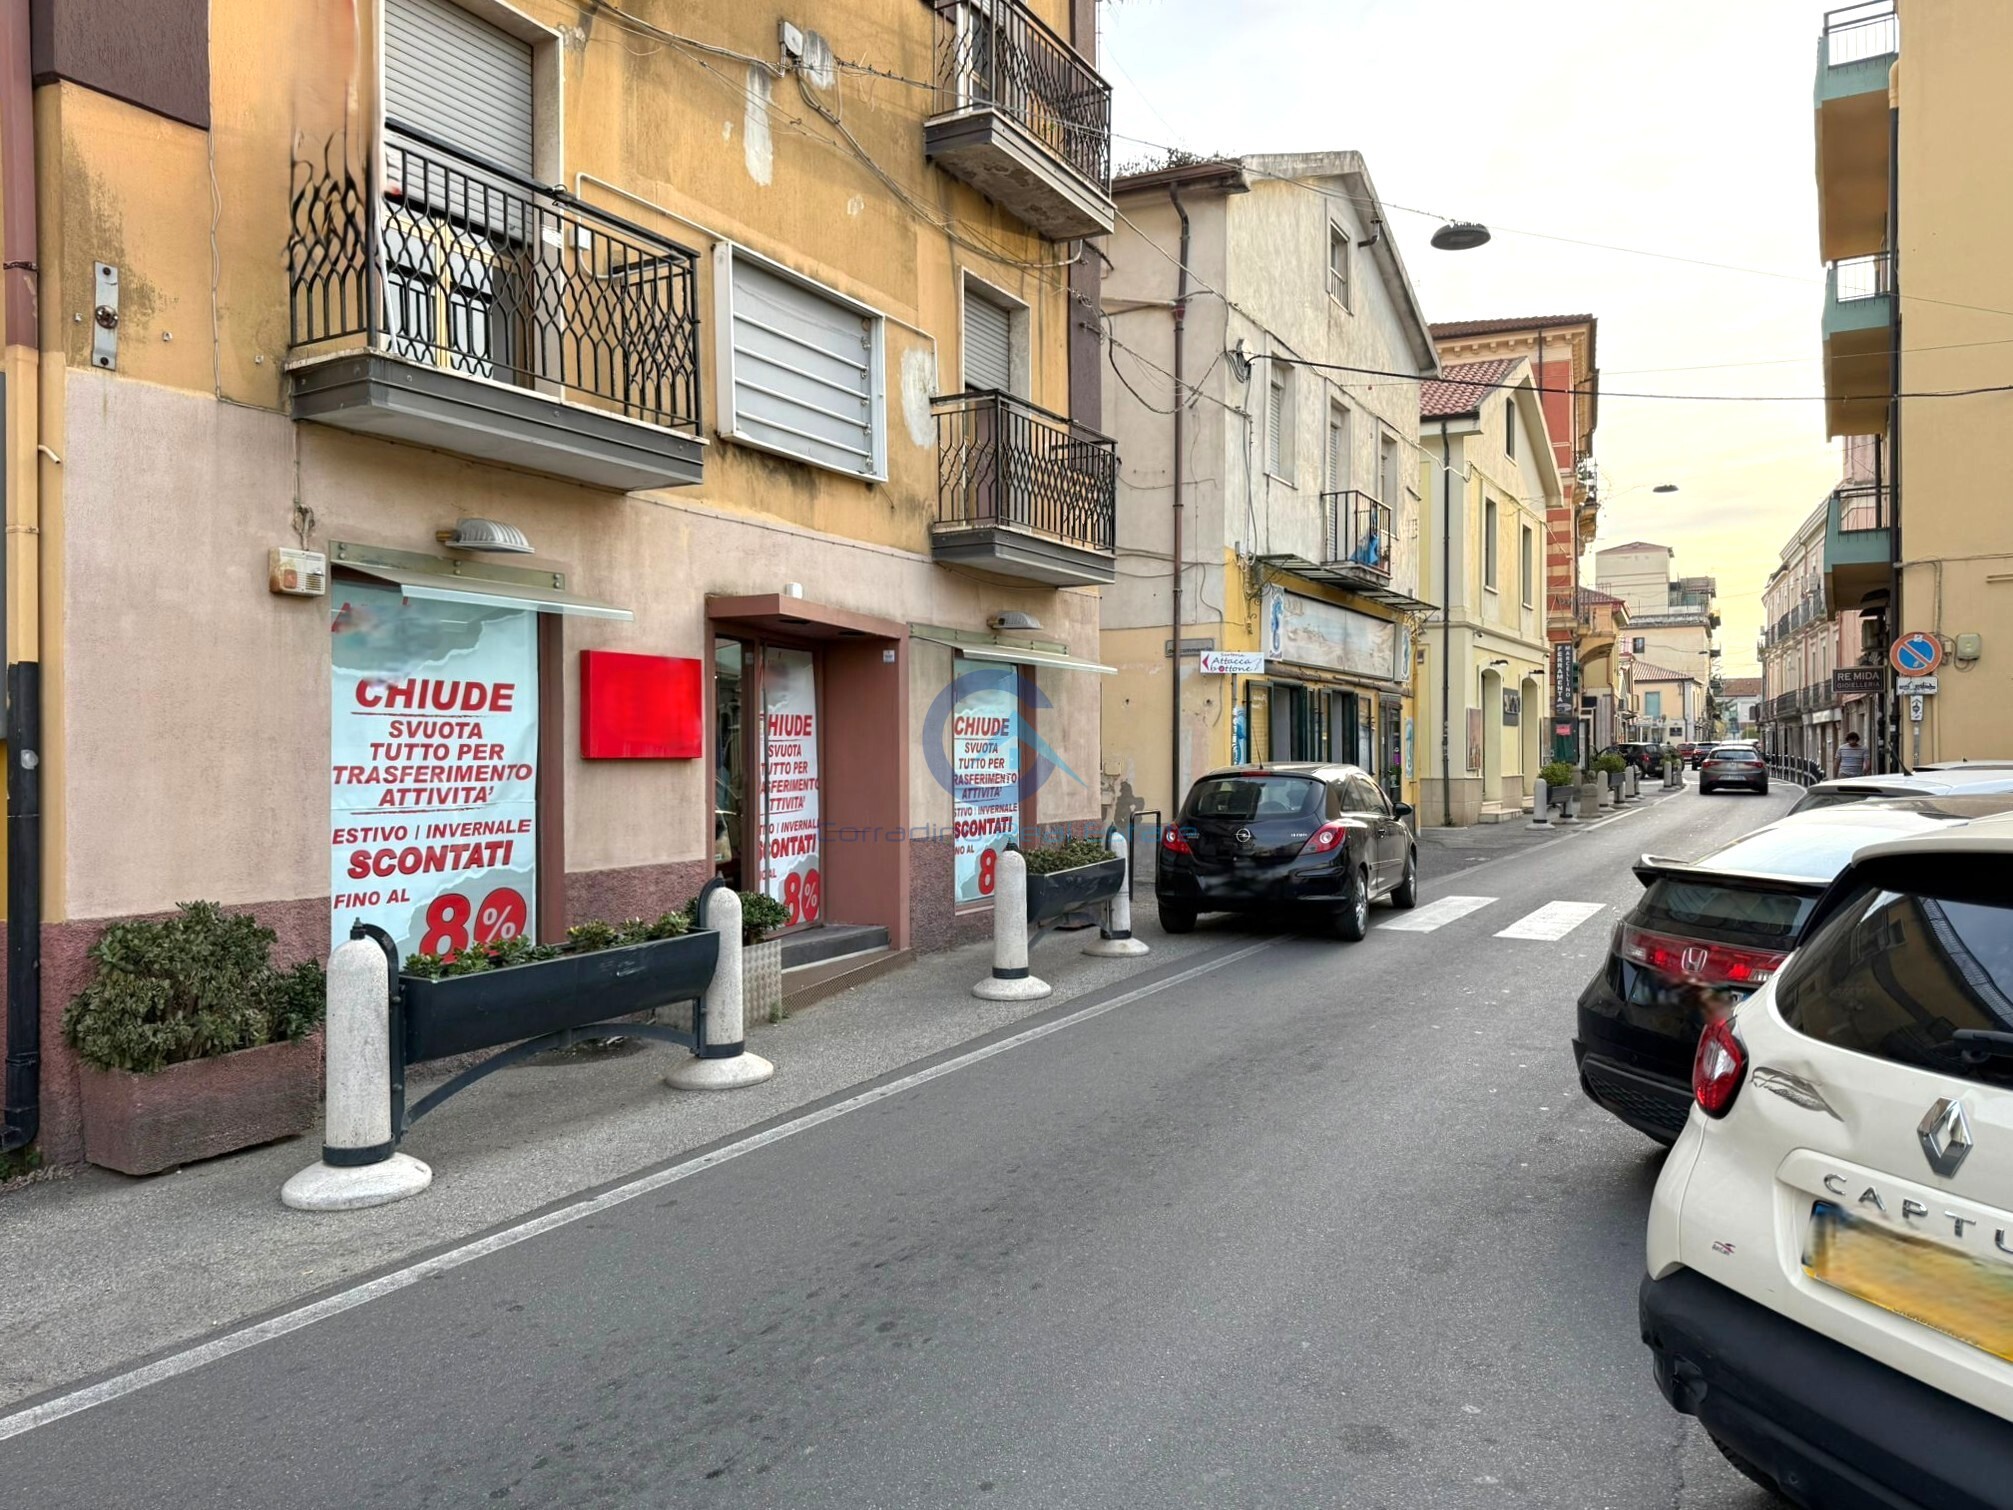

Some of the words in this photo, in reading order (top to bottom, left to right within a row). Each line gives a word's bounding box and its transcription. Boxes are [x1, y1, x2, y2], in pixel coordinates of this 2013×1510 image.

[1556, 645, 1564, 703] FERRAMENTA
[1837, 672, 1851, 681] RE
[355, 678, 515, 712] CHIUDE
[388, 720, 483, 740] SVUOTA
[760, 712, 813, 737] HIUDE
[954, 716, 1010, 737] CHIUDE
[369, 742, 450, 762] TUTTO
[457, 743, 505, 762] PER
[768, 744, 802, 757] SVUOTA
[964, 742, 999, 754] SVUOTA
[332, 763, 533, 785] TRASFERIMENTO
[793, 760, 808, 774] PER
[959, 758, 986, 770] TUTTO
[988, 758, 1005, 769] PER
[978, 803, 1018, 815] INVERNALE
[332, 825, 408, 845] ESTIVO
[425, 819, 532, 839] INVERNALE
[954, 816, 1013, 839] SCONTATI
[966, 844, 975, 854] AL
[347, 840, 514, 880] SCONTATI
[333, 890, 381, 909] FINO
[386, 888, 410, 904] AL
